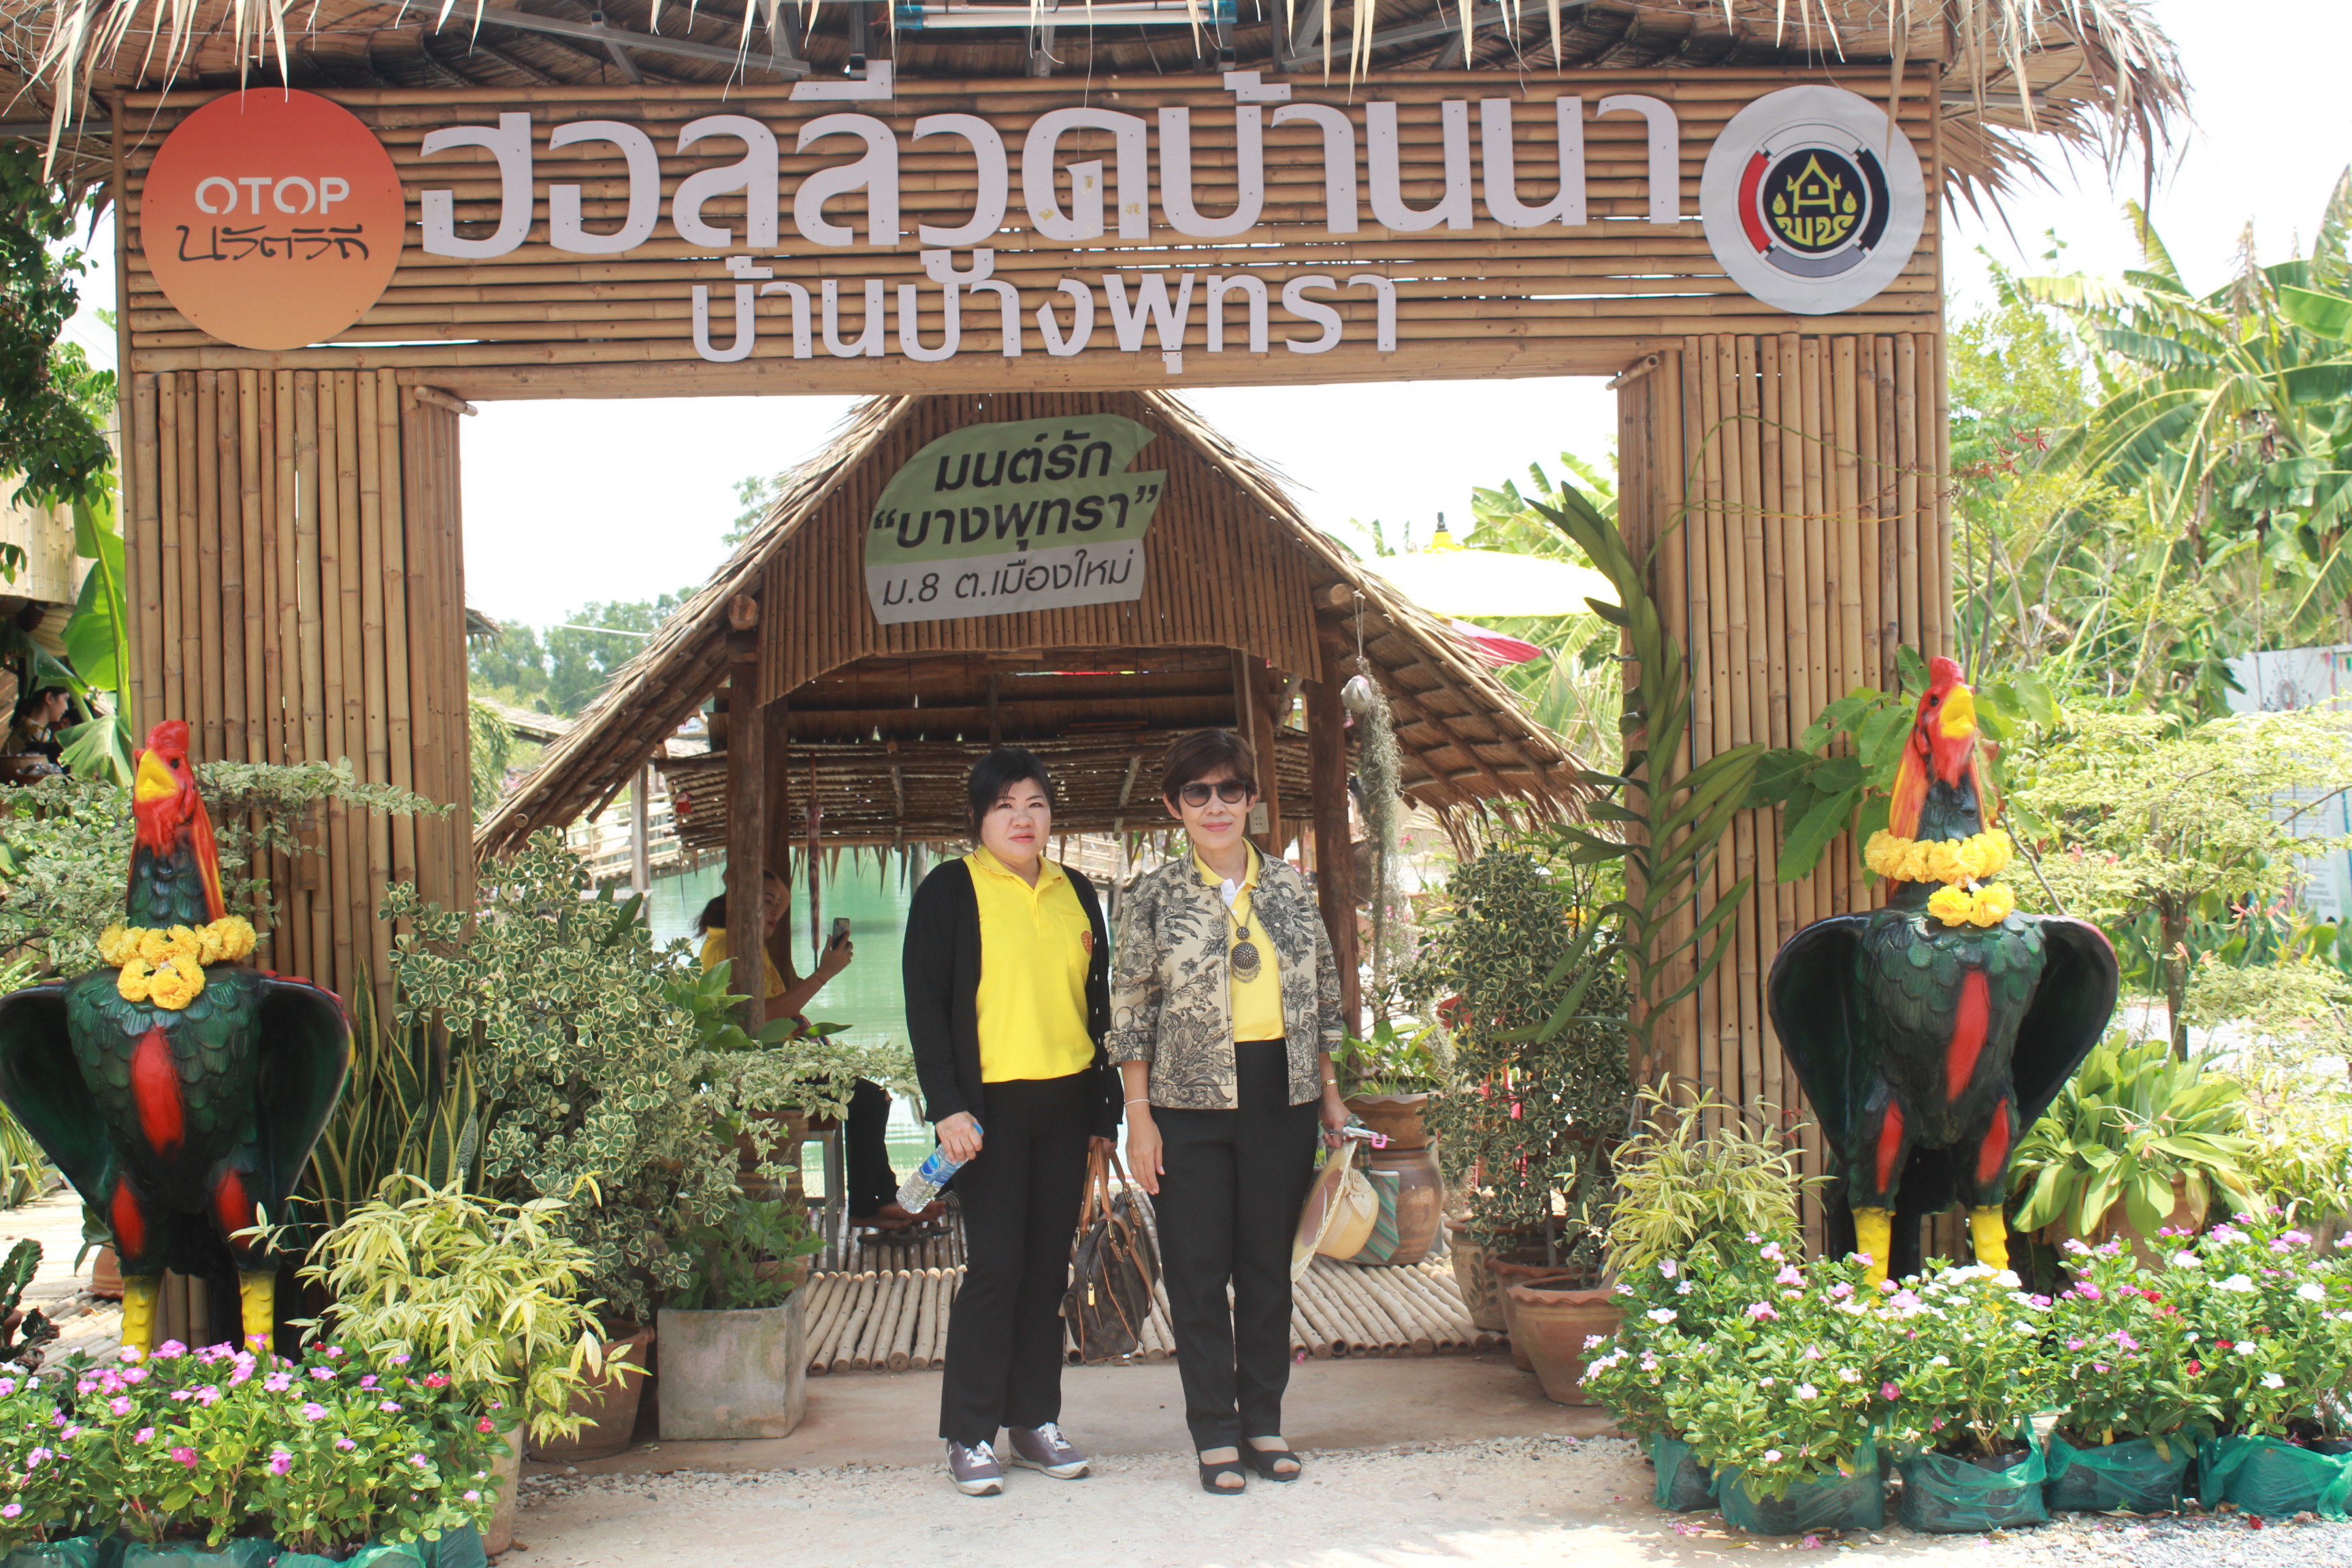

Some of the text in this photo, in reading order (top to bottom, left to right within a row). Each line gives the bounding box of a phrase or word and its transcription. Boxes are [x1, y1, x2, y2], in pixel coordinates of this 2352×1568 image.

[195, 175, 350, 215] OTOP
[691, 256, 1397, 375] บ้านบางพุทรา
[933, 429, 1113, 492] มนต์รัก
[883, 548, 1134, 606] ม.8 ต.เมืองใหม่
